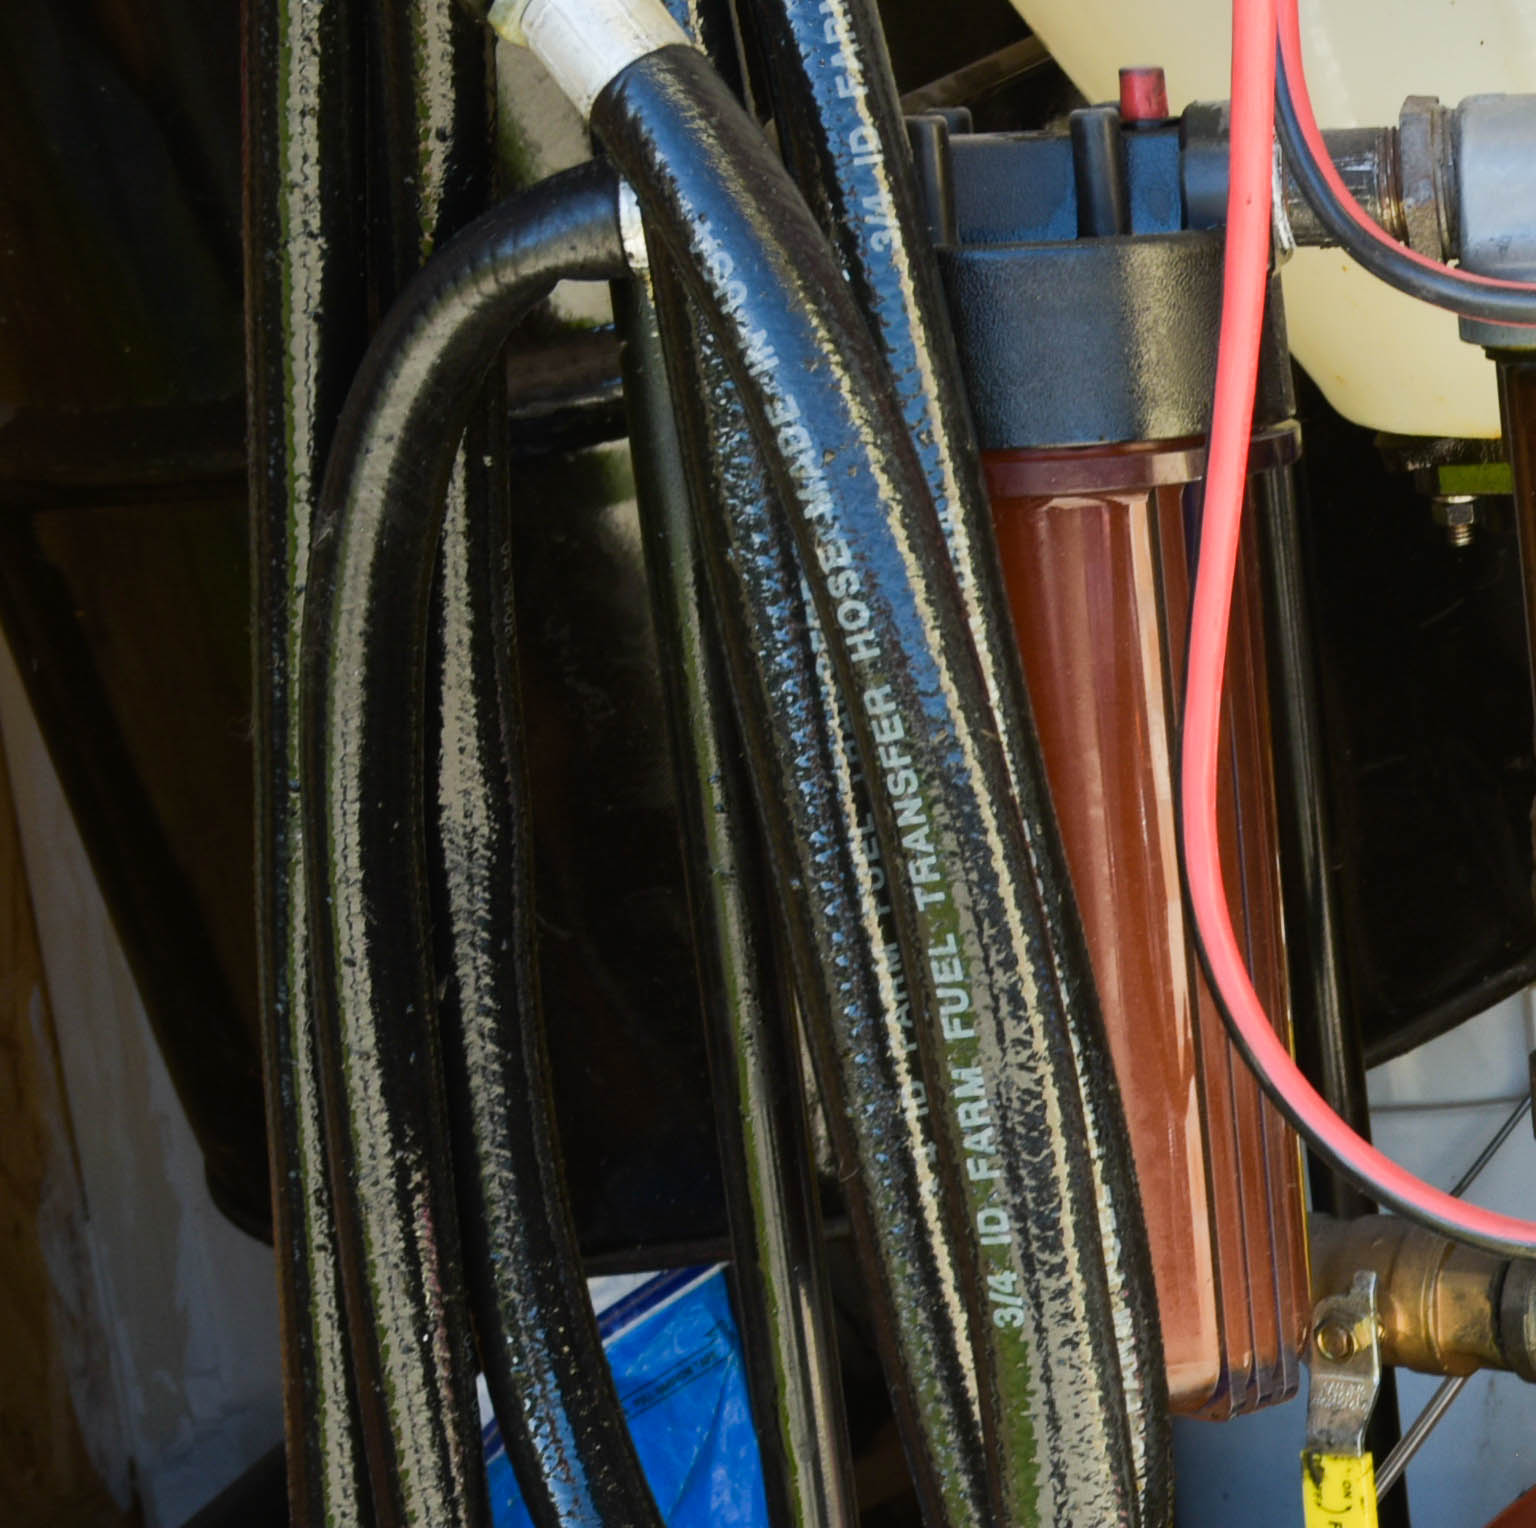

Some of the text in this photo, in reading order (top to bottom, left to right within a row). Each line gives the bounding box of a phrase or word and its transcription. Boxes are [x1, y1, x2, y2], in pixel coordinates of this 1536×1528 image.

[849, 124, 884, 166] ID
[817, 536, 881, 663] HOSE
[863, 683, 947, 912] TRANSFER
[928, 933, 976, 1042] FUEL
[954, 1067, 1004, 1182] FARM
[976, 1204, 1011, 1246] ID
[993, 1268, 1026, 1330] 3/4
[1341, 1479, 1352, 1501] ON
